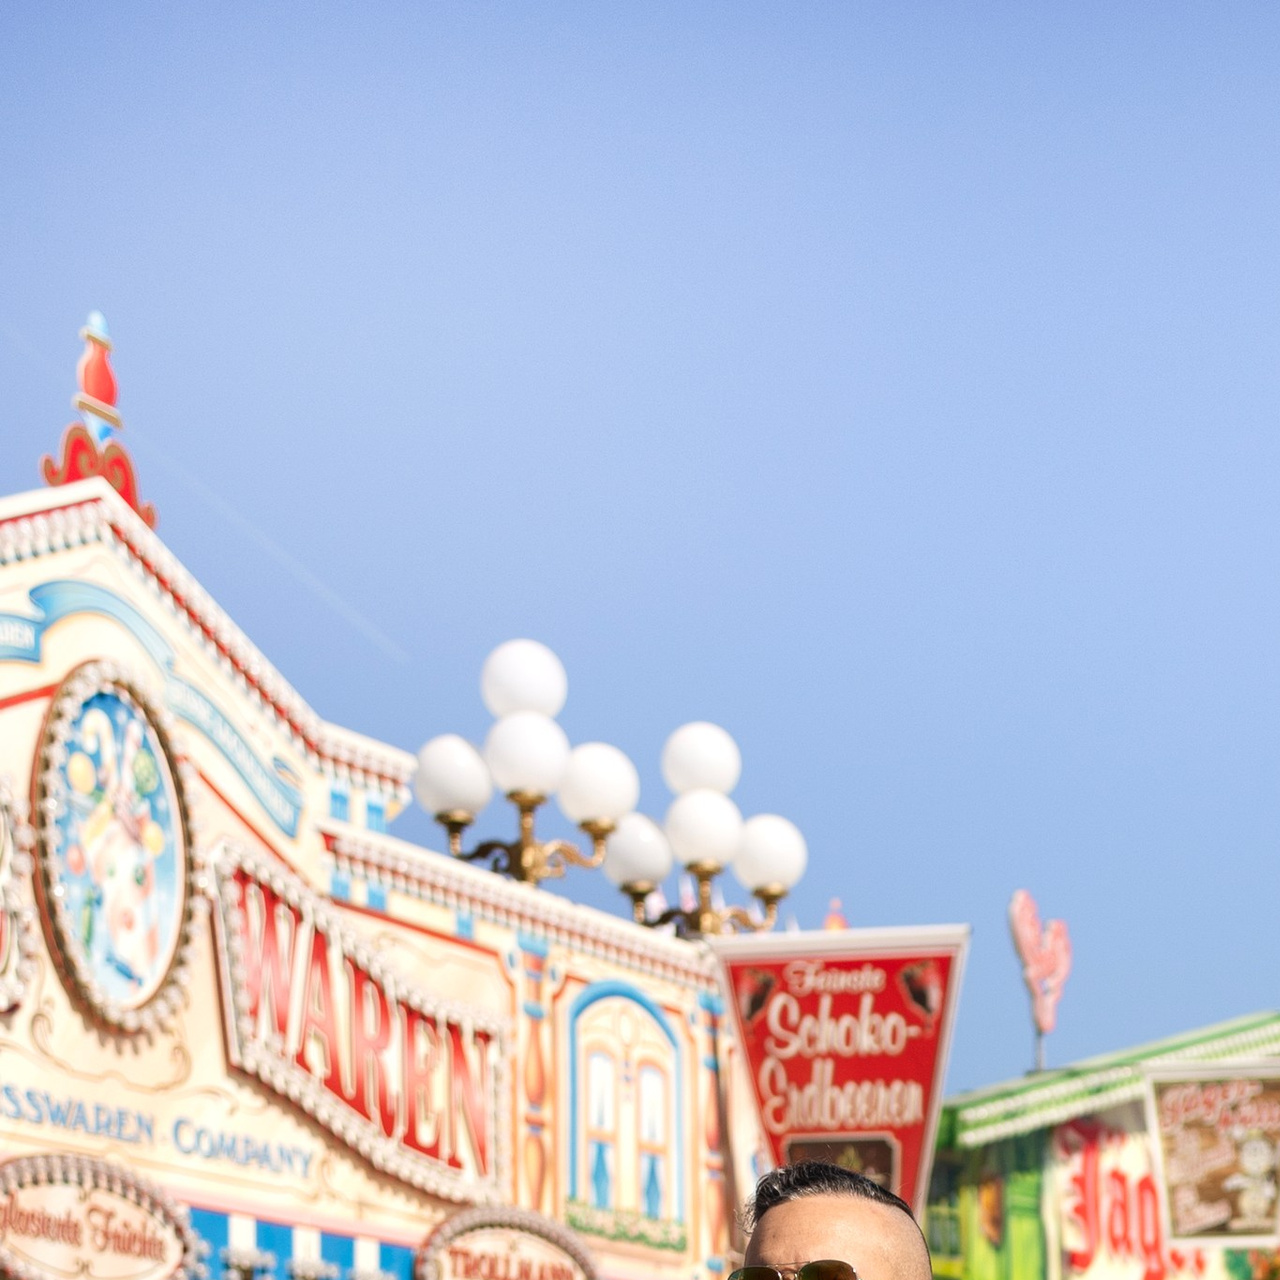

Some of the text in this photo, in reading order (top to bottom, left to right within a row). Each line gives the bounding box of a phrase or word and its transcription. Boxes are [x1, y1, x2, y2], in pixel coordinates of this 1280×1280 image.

[233, 866, 492, 1178] WAREN
[764, 992, 922, 1059] Schoko-
[759, 1056, 925, 1135] Erdbeeren
[172, 1115, 316, 1178] COMPANY
